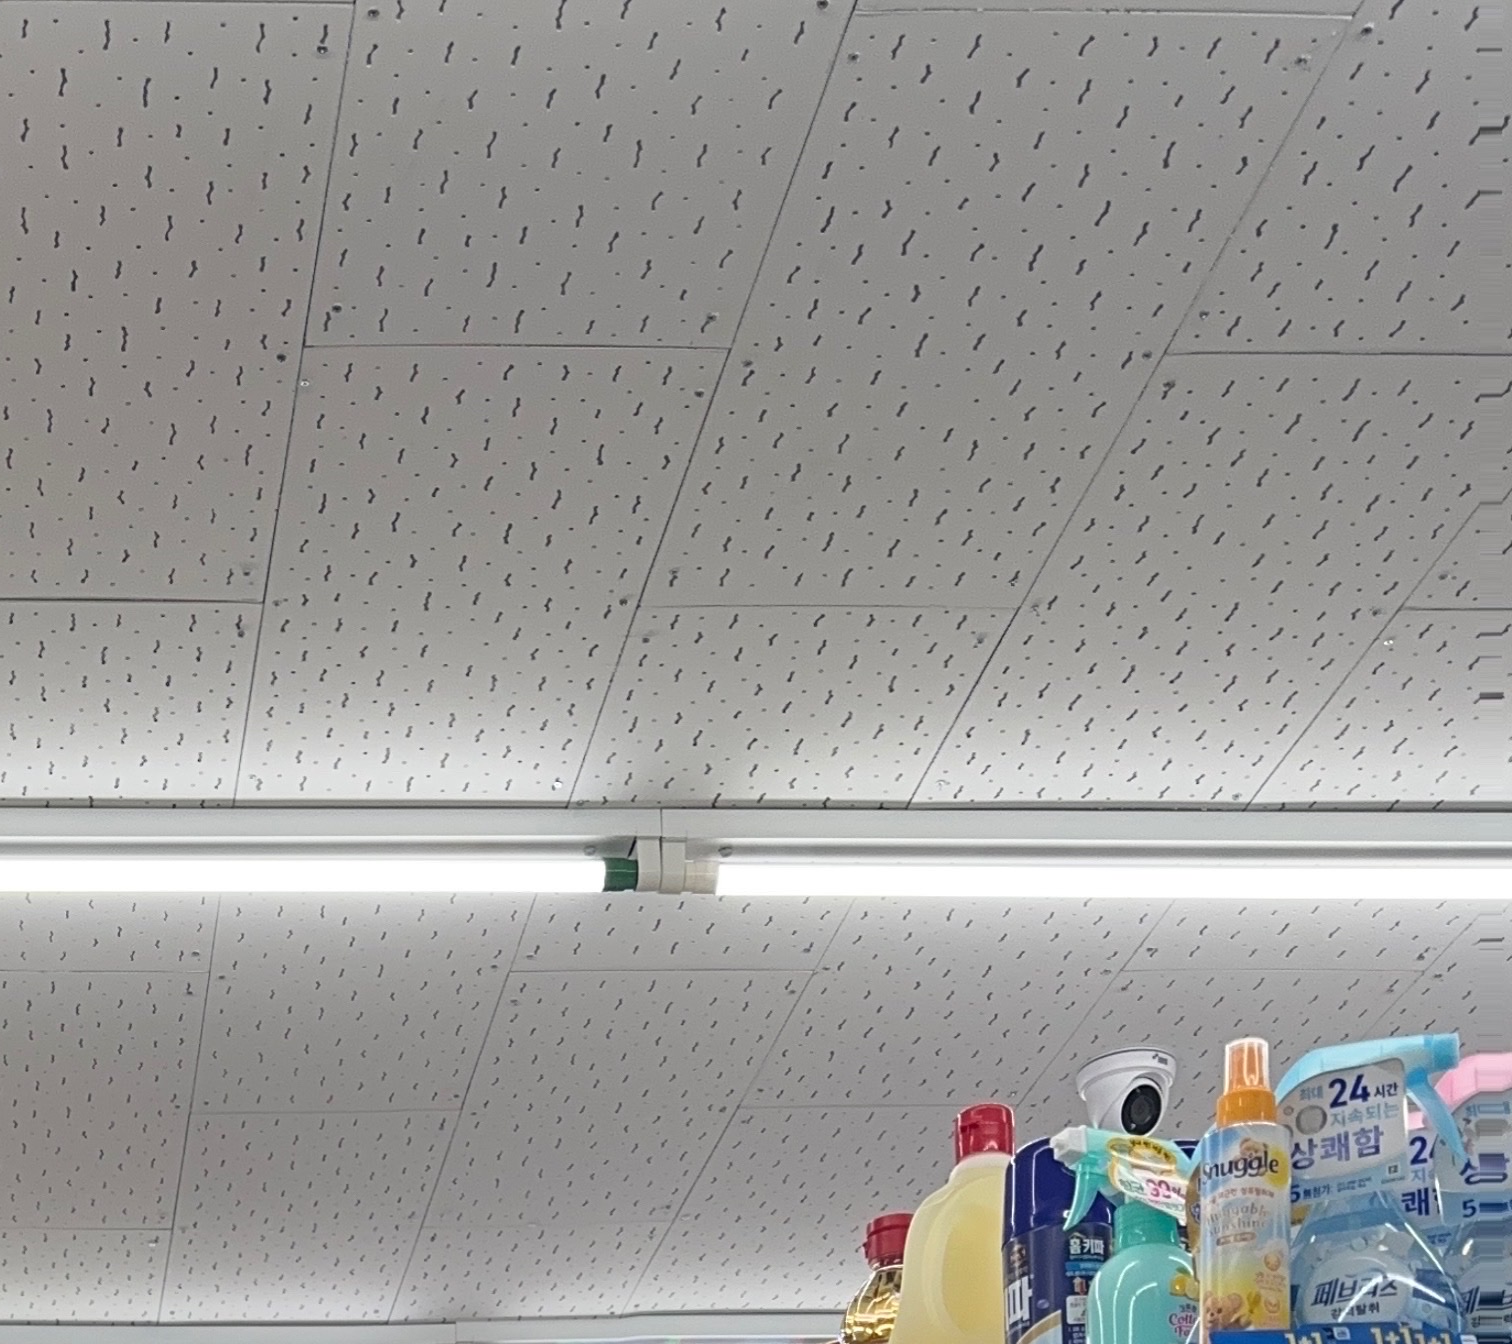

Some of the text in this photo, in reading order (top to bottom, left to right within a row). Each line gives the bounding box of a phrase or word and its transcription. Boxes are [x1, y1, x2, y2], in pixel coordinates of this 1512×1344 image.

[1328, 1074, 1370, 1109] 24
[1374, 1082, 1399, 1099] 시간
[1330, 1102, 1399, 1127] 지속되는
[1291, 1125, 1384, 1170] 상쾌함
[1203, 1148, 1279, 1186] Snuggle
[1067, 1237, 1106, 1256] 홈키파
